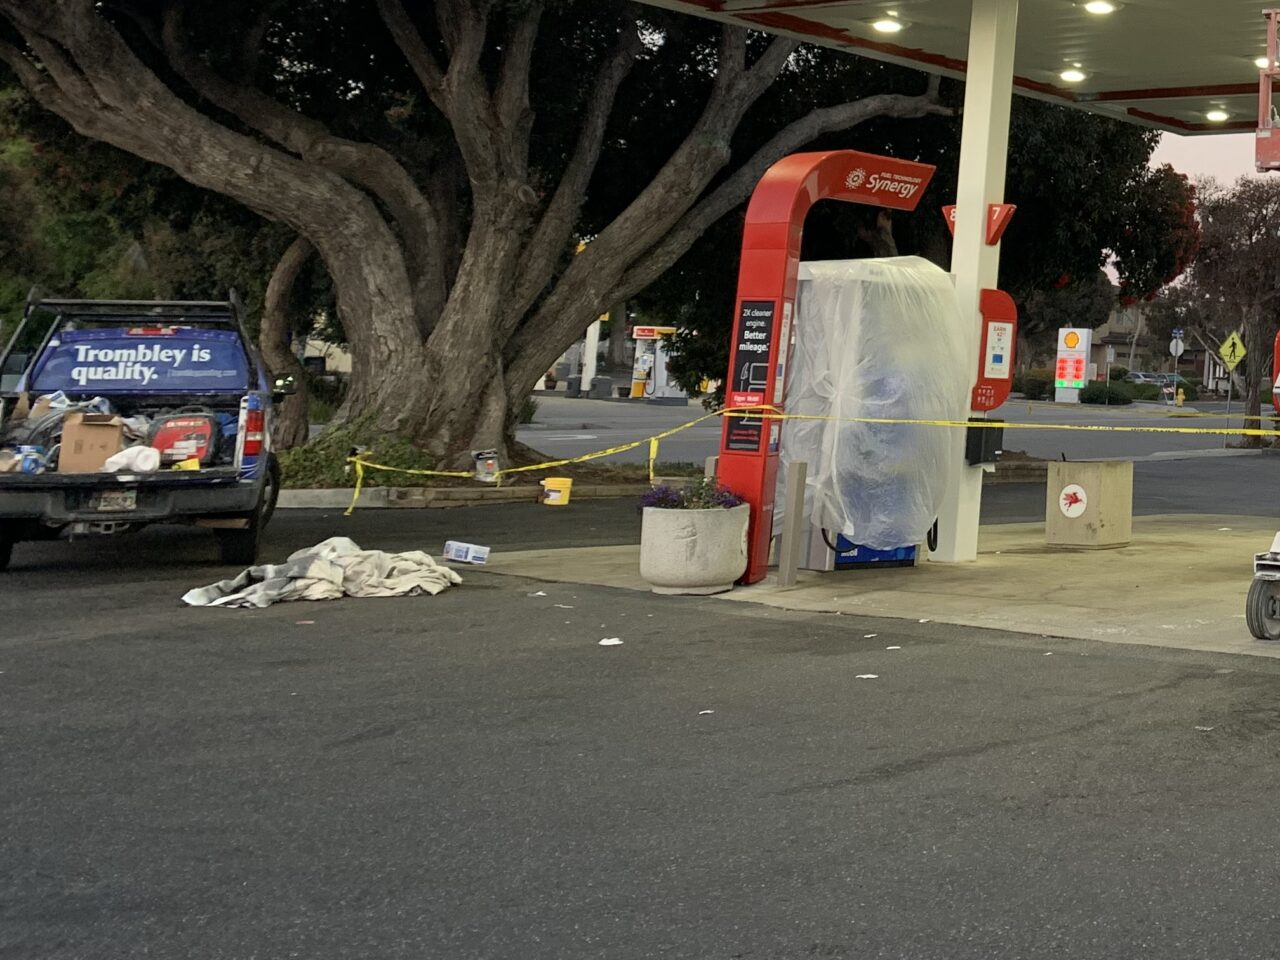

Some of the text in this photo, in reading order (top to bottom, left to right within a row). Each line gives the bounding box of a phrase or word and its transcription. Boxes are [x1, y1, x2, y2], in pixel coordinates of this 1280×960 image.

[866, 174, 918, 198] Synergy
[949, 208, 957, 222] 8
[992, 206, 1001, 220] 7
[751, 308, 773, 317] cleaner
[745, 320, 767, 329] engine.
[743, 330, 767, 340] Better
[74, 344, 212, 367] Trombley is
[71, 362, 159, 386] quality.
